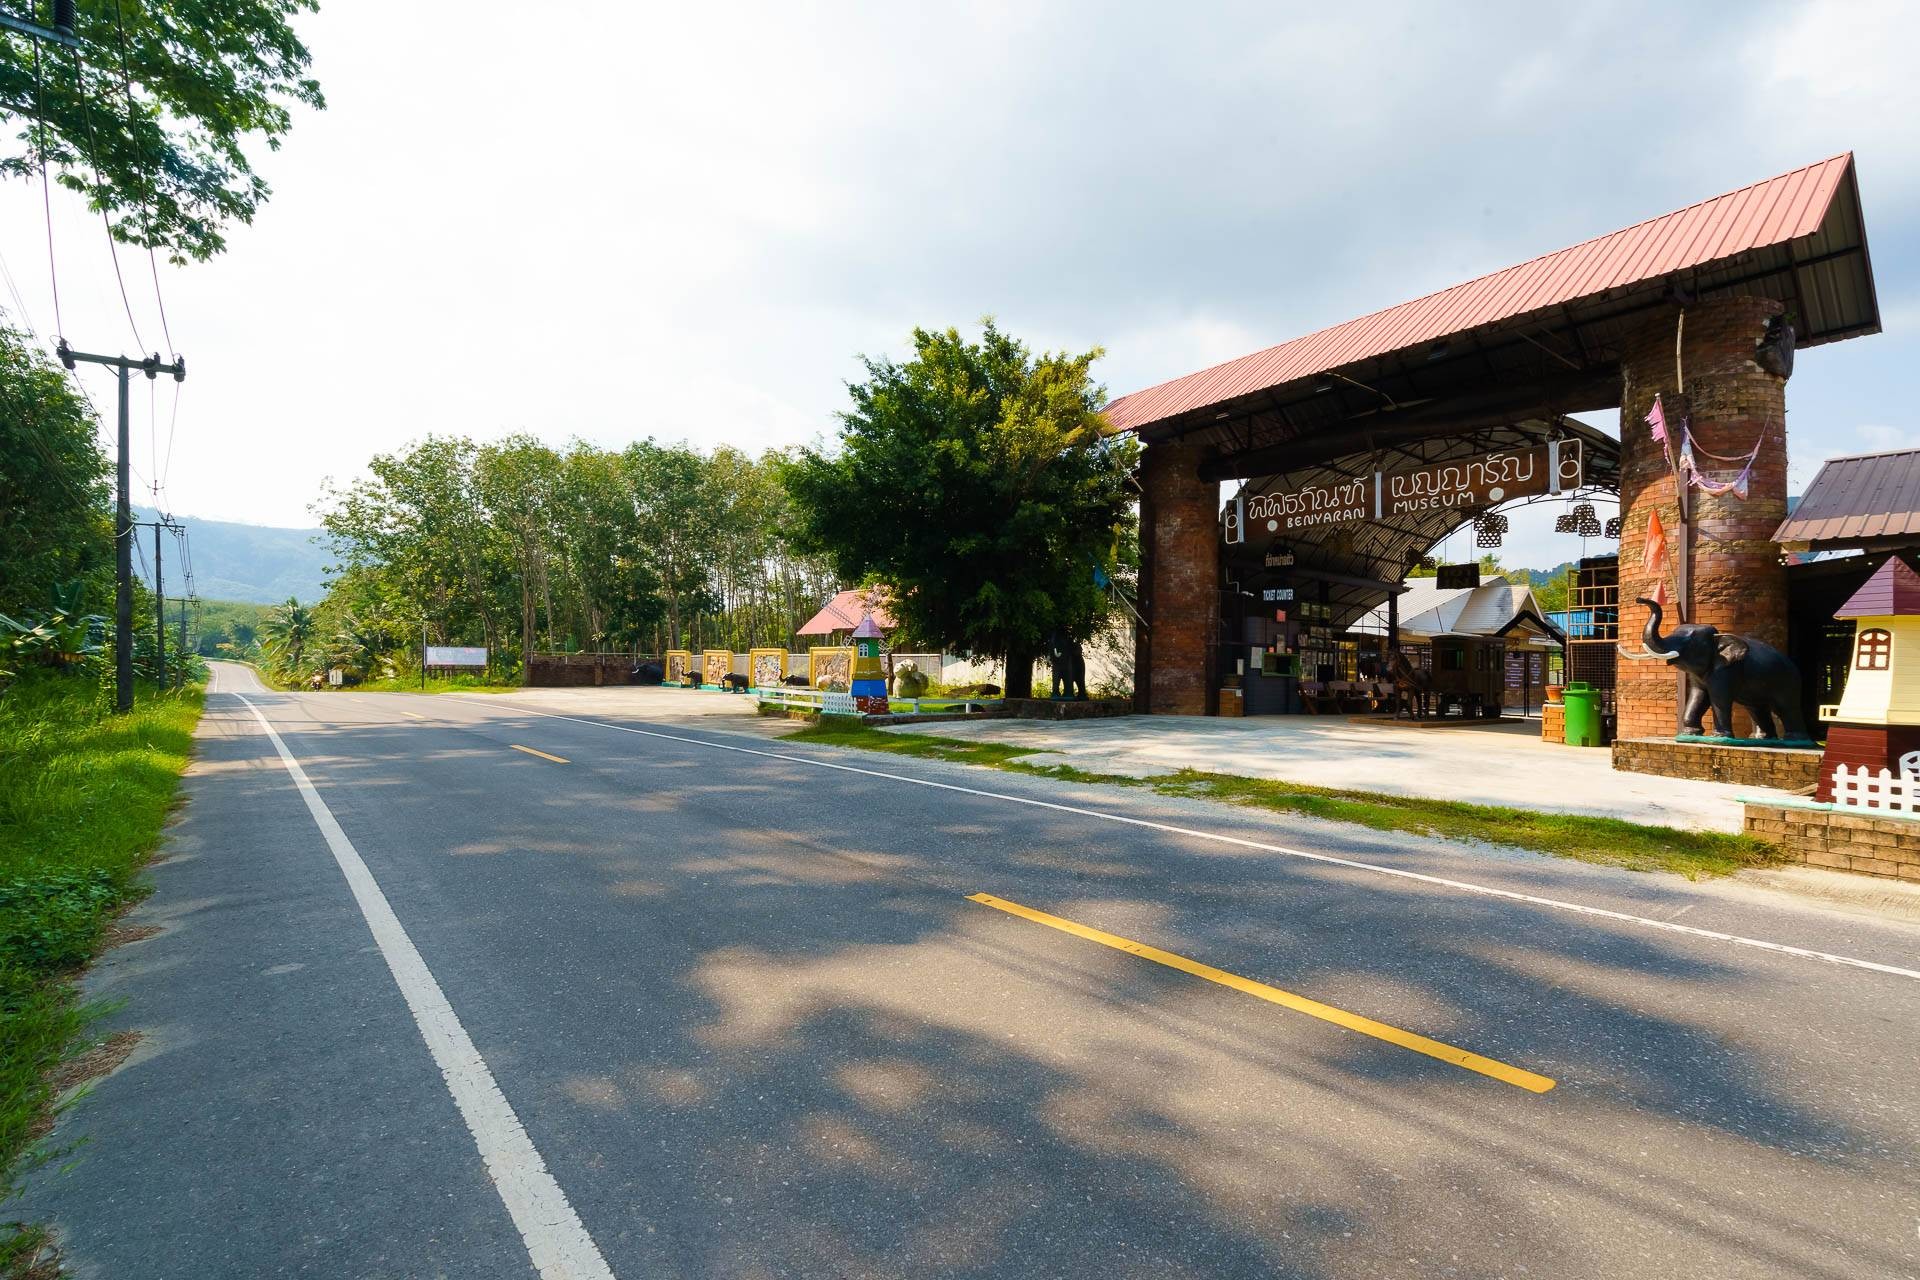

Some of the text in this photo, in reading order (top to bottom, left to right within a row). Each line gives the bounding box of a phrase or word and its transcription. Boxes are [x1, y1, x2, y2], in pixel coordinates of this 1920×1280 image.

[1249, 476, 1368, 519] พิพิธภัณฑ์
[1287, 491, 1474, 528] BENYARAN MUSEUM
[1263, 588, 1294, 601] TICKET COUNTER
